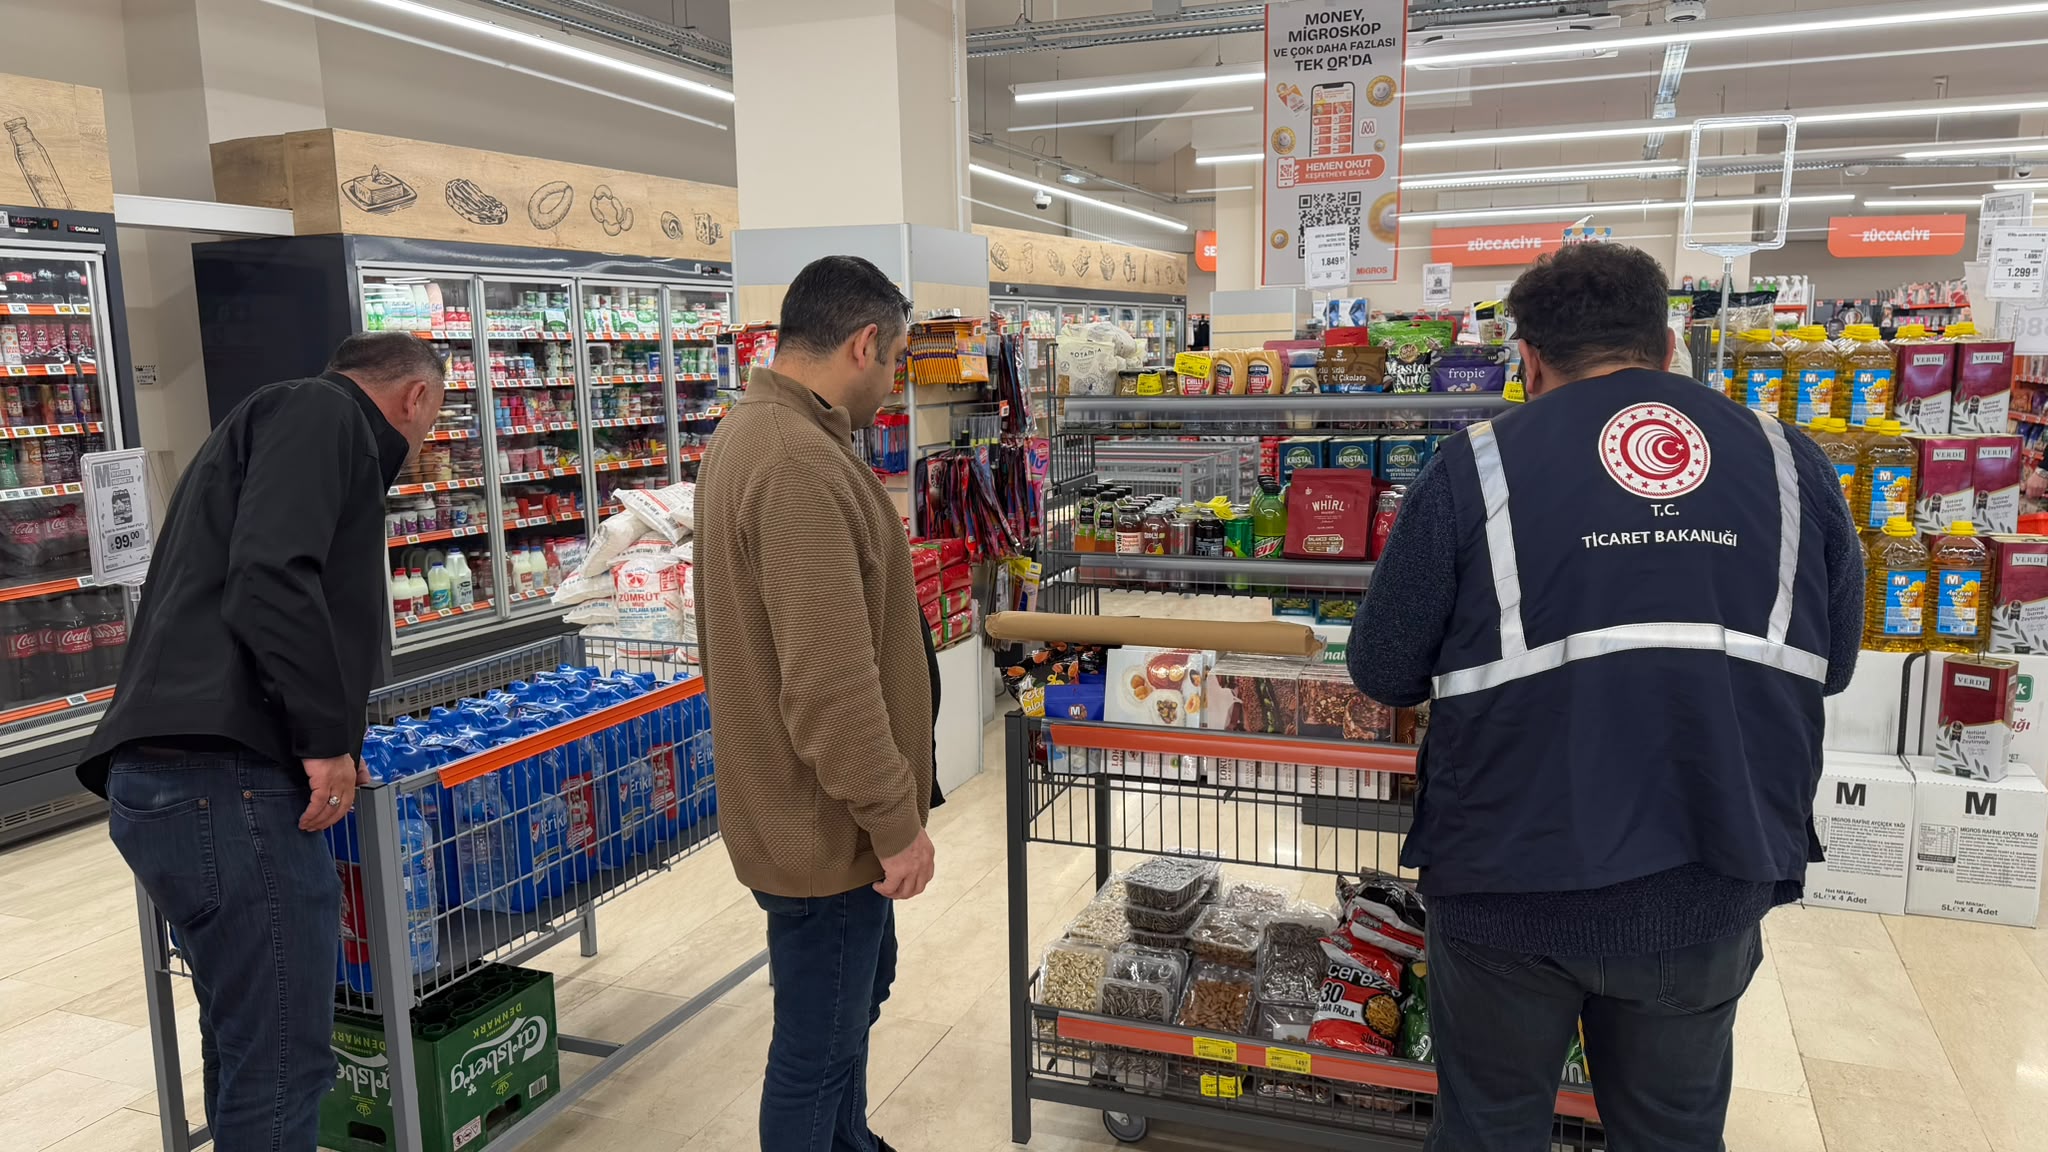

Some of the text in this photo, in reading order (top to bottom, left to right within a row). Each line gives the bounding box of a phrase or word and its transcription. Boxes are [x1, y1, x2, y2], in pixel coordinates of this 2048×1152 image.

[1305, 9, 1365, 26] MONEY,
[1288, 22, 1381, 42] MİGROSKOP
[1273, 37, 1396, 58] VE ÇOK DAHA FAZLASI
[1295, 53, 1372, 72] TEK QR'DA
[1306, 158, 1372, 172] HEMEN OKUT
[1348, 168, 1370, 177] BAŞLA
[1862, 226, 1930, 242] ZÜCCACİYE
[1467, 234, 1542, 252] ZÜCCACİYE
[2008, 267, 2030, 278] 1.299
[1448, 368, 1485, 382] fropie
[1286, 456, 1312, 464] KRISTAL
[1338, 455, 1364, 463] KRISTAL
[1389, 454, 1416, 462] KRISTAL
[1312, 500, 1344, 512] WHIRL
[1650, 504, 1680, 516] T.C.
[1582, 529, 1738, 548] TİCARET BAKANLIĞI
[618, 592, 660, 602] ZÜMRÜT
[1957, 676, 1988, 687] VERDE
[1070, 706, 1081, 716] M
[1836, 782, 1866, 806] M
[1965, 791, 1997, 816] M
[2002, 830, 2025, 838] AYÇİÇEK
[1846, 895, 1867, 904] Adet
[1976, 907, 1998, 916] Adet
[1320, 982, 1344, 1004] 30
[1332, 1004, 1356, 1018] FAZLA
[473, 1002, 522, 1039] DENMARK
[450, 1015, 548, 1094] Carlsberg
